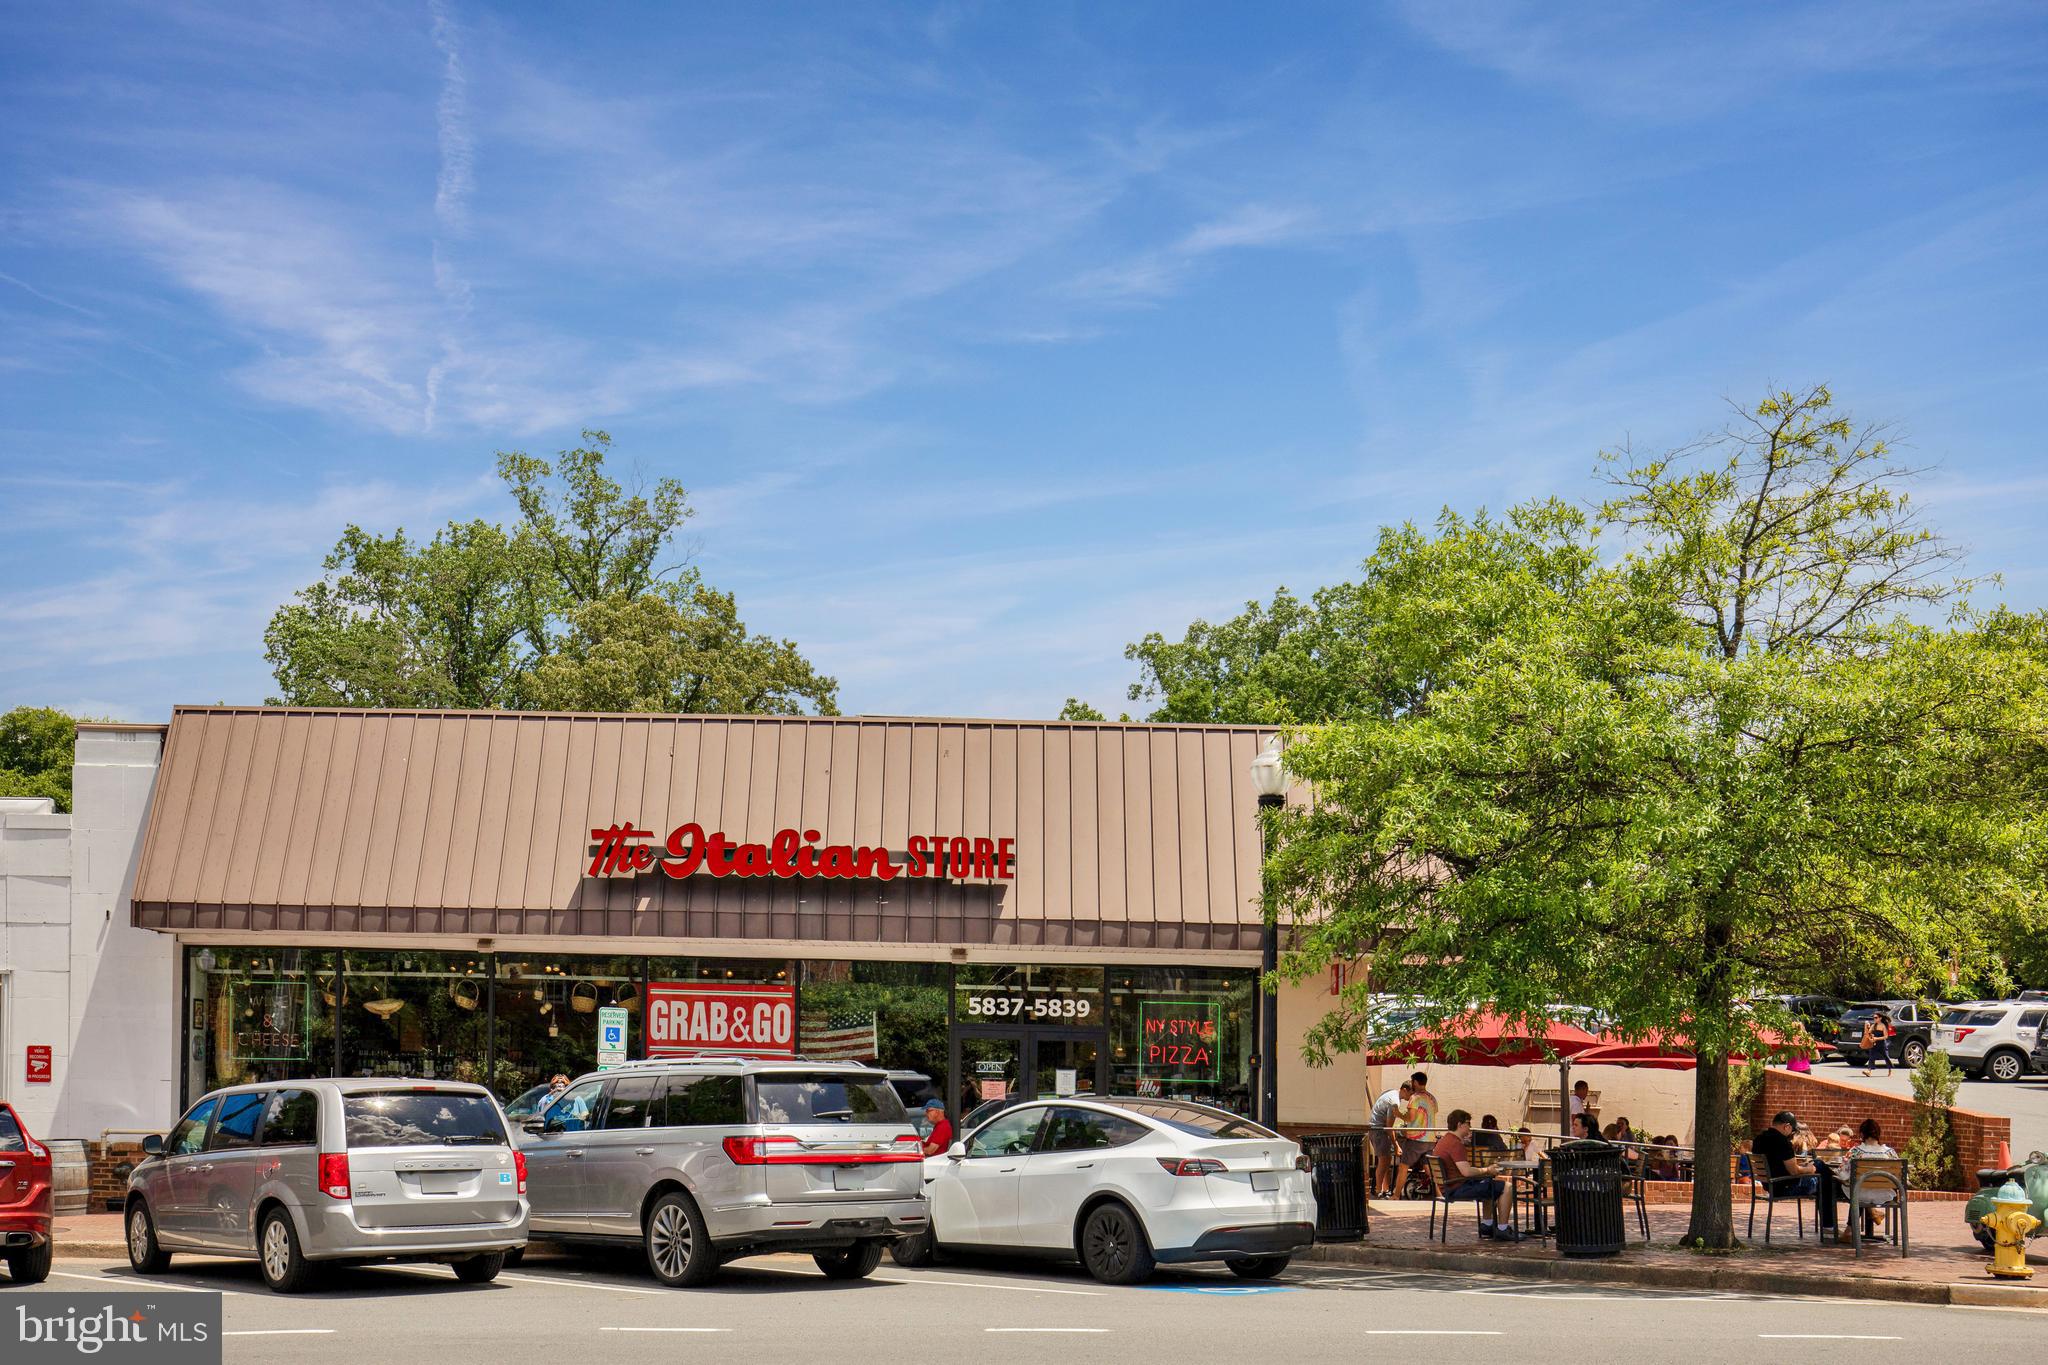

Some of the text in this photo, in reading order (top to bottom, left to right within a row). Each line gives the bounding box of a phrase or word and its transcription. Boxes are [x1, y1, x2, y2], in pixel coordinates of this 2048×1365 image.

[588, 821, 1016, 881] The Italian STORE
[601, 1011, 626, 1019] RESERVED
[968, 997, 1091, 1018] 5837-5839
[650, 999, 792, 1044] GRAB&GO
[1145, 1018, 1215, 1036] NY STYLE
[238, 1032, 300, 1048] CHEESE
[1149, 1043, 1210, 1066] PIZZA
[978, 1062, 1003, 1072] OPEN
